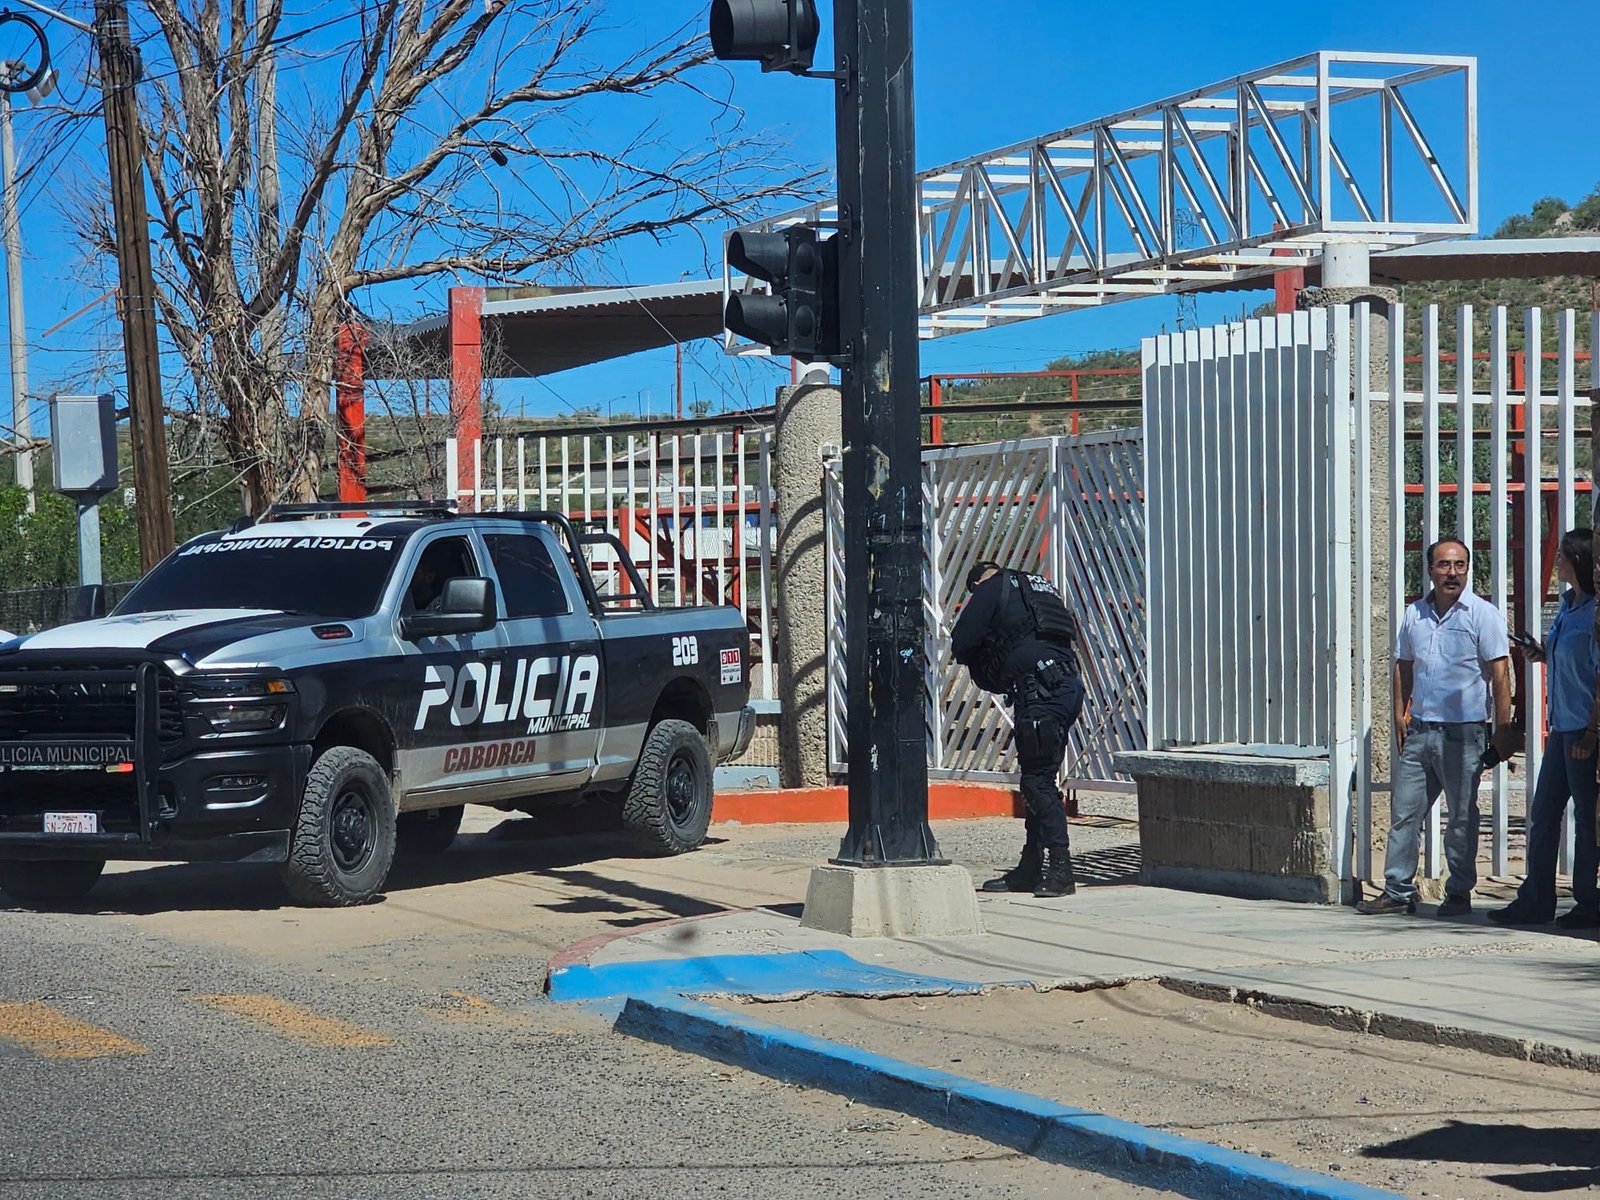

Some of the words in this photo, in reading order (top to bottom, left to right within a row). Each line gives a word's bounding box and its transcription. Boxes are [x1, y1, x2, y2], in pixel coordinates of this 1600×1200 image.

[672, 635, 699, 666] 203
[722, 651, 739, 664] 911
[413, 654, 600, 731] POLICIA
[526, 712, 592, 735] MUNICIPAL
[0, 746, 43, 762] LICIA
[46, 746, 135, 762] MUNICIPAL
[443, 740, 537, 774] CABORCA
